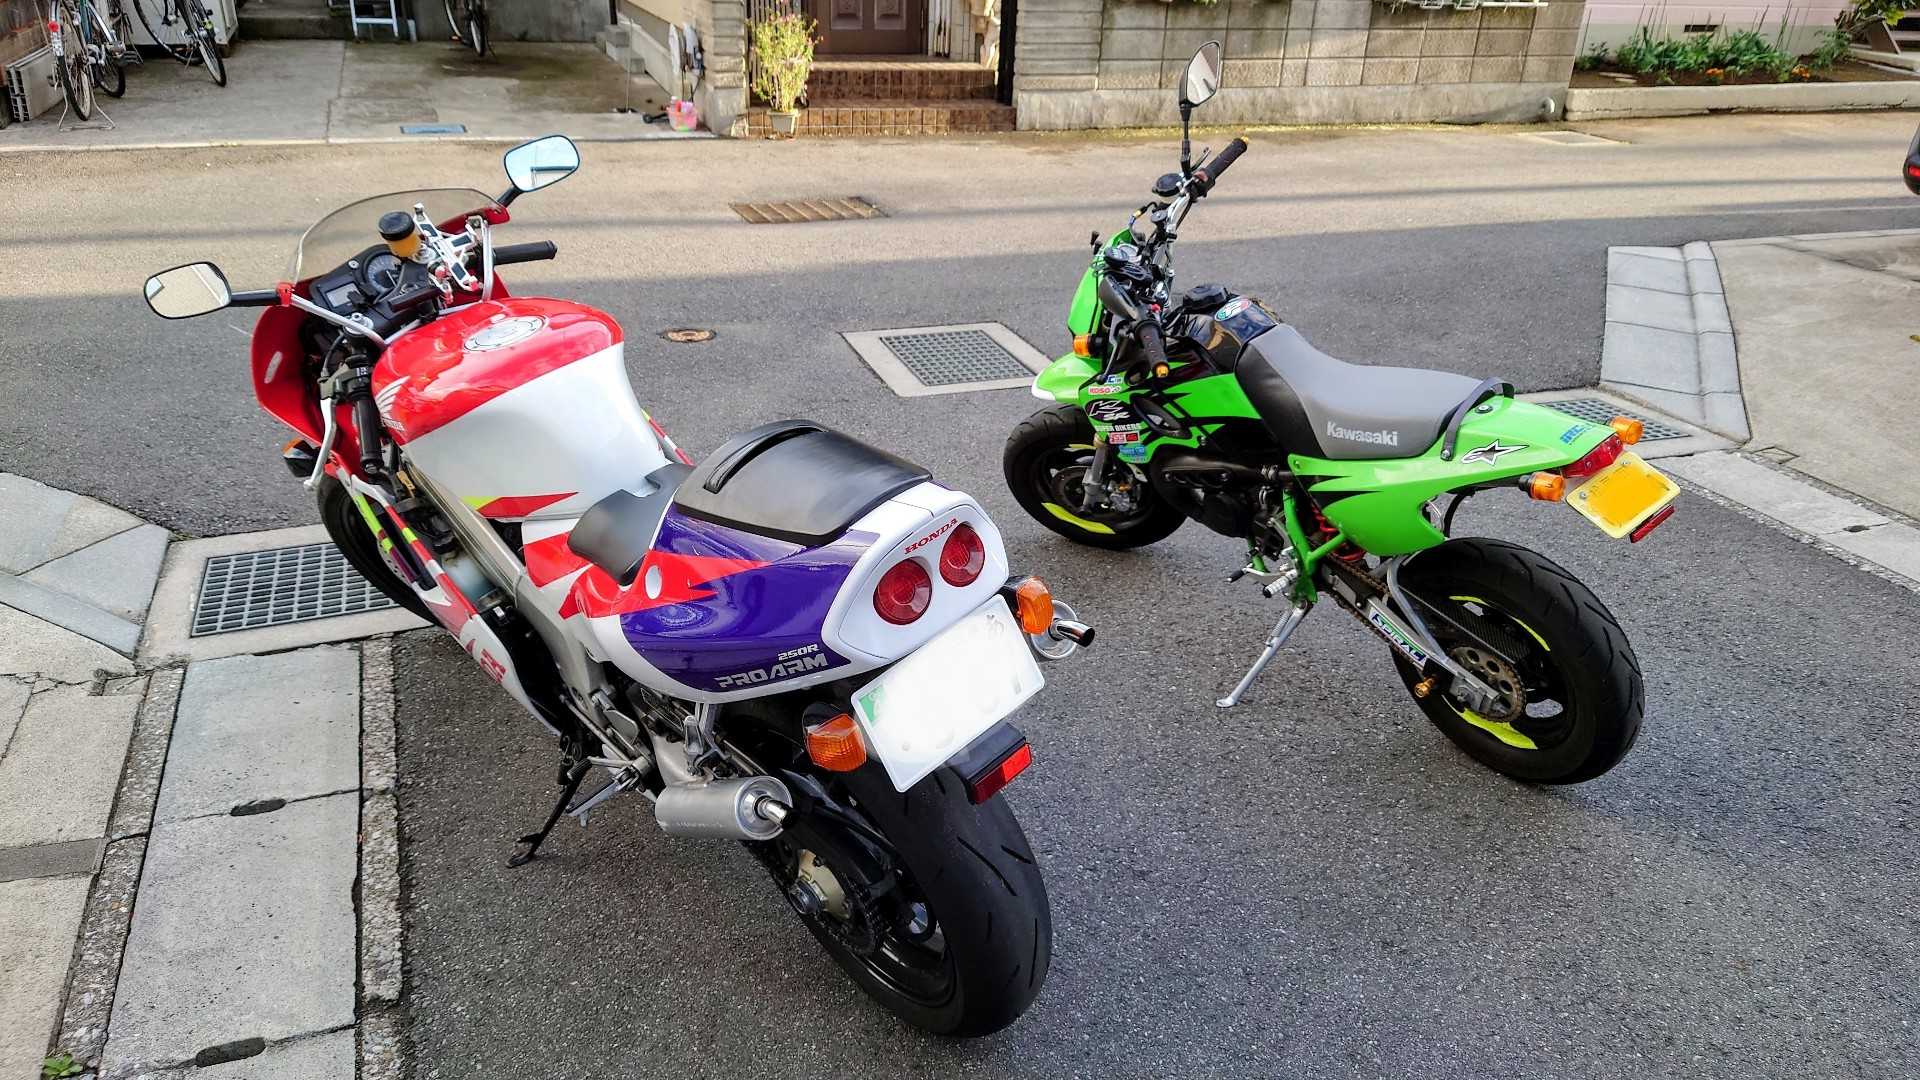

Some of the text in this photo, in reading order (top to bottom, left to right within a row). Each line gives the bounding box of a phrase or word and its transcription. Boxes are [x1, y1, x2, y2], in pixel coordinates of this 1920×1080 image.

[1327, 421, 1398, 447] Kawasaki
[904, 518, 958, 554] HONDA
[778, 643, 820, 661] 250R
